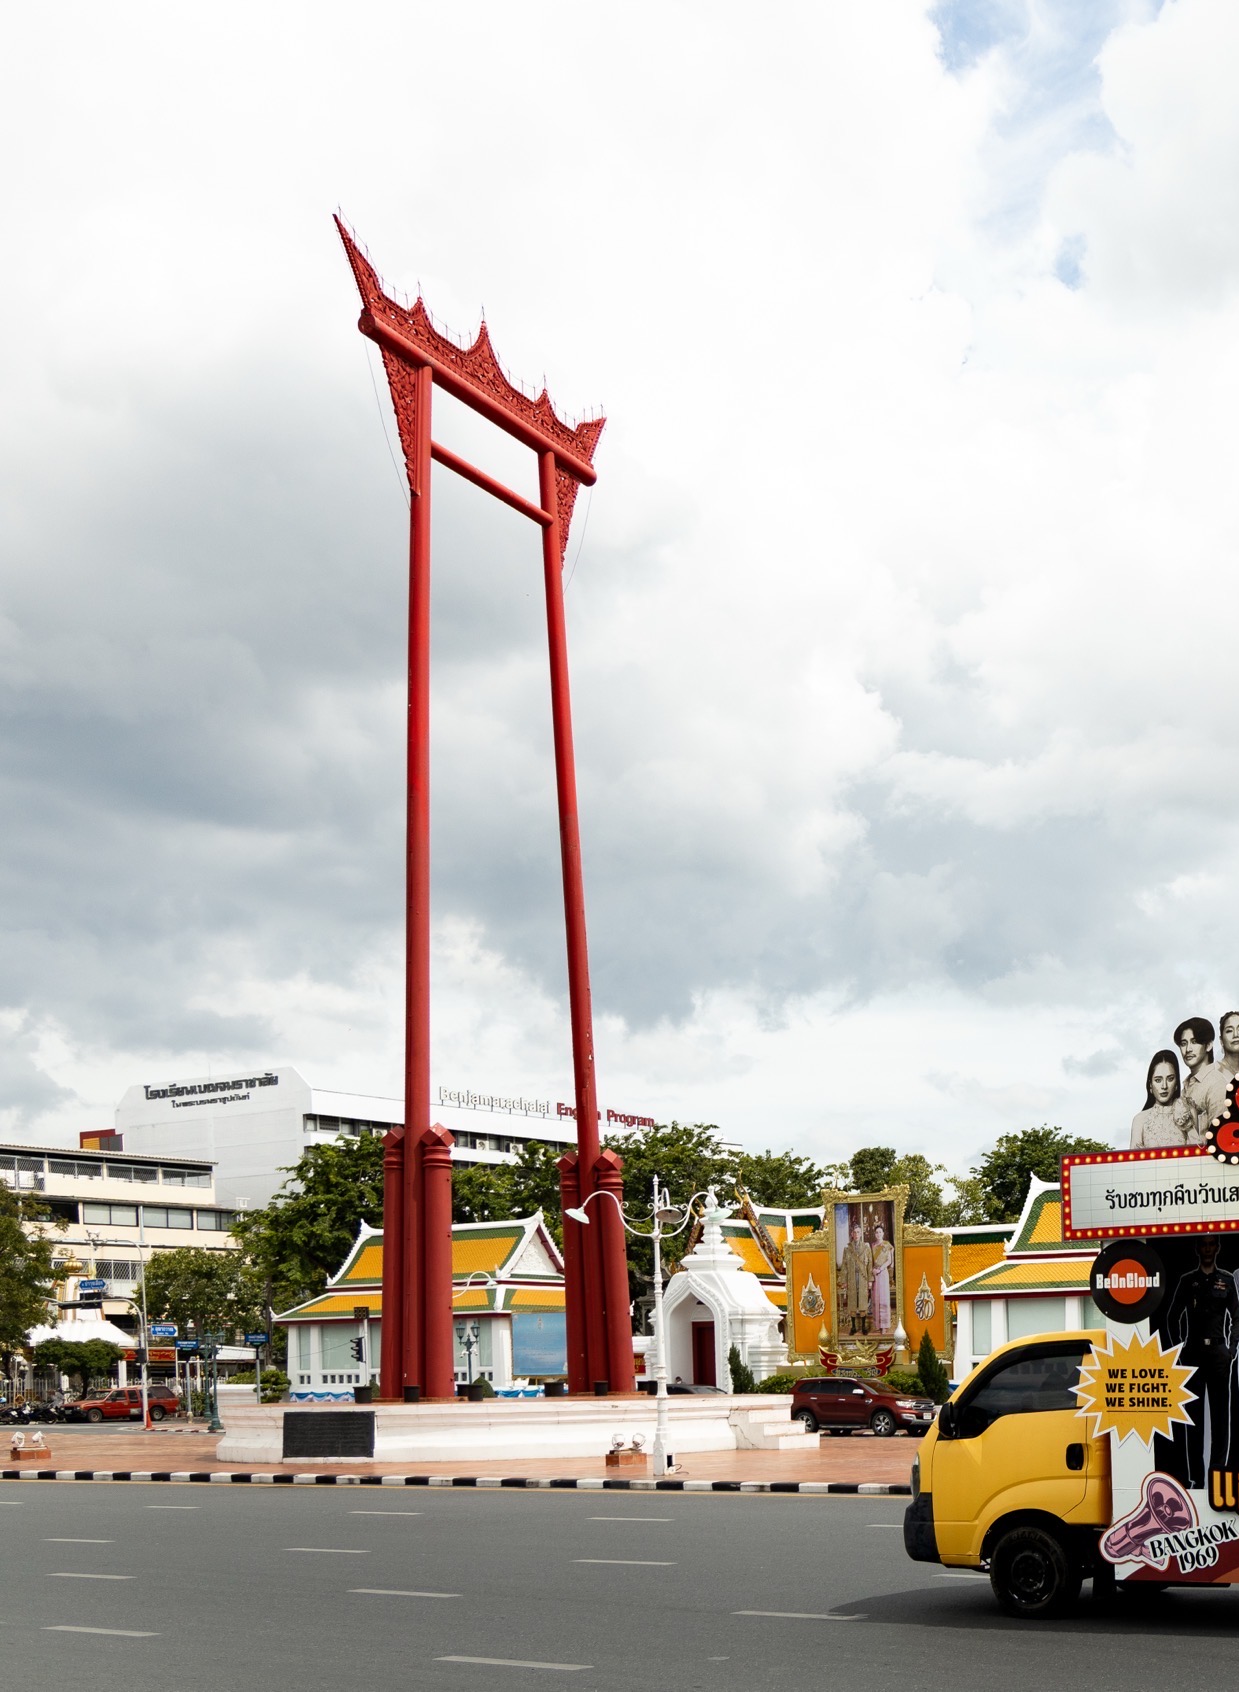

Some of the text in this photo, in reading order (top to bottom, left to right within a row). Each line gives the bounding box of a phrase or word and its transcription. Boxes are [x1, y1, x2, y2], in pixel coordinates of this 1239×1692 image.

[439, 1086, 551, 1114] Benjamarachalai
[606, 1109, 655, 1127] Program
[1096, 1272, 1161, 1289] BeOnCloud
[1108, 1368, 1169, 1379] WE LOVE.
[1105, 1382, 1172, 1393] WE FIGHT.
[1105, 1397, 1172, 1408] WE SHINE.
[1149, 1519, 1238, 1559] BANGKOK
[1178, 1545, 1218, 1571] 1969
